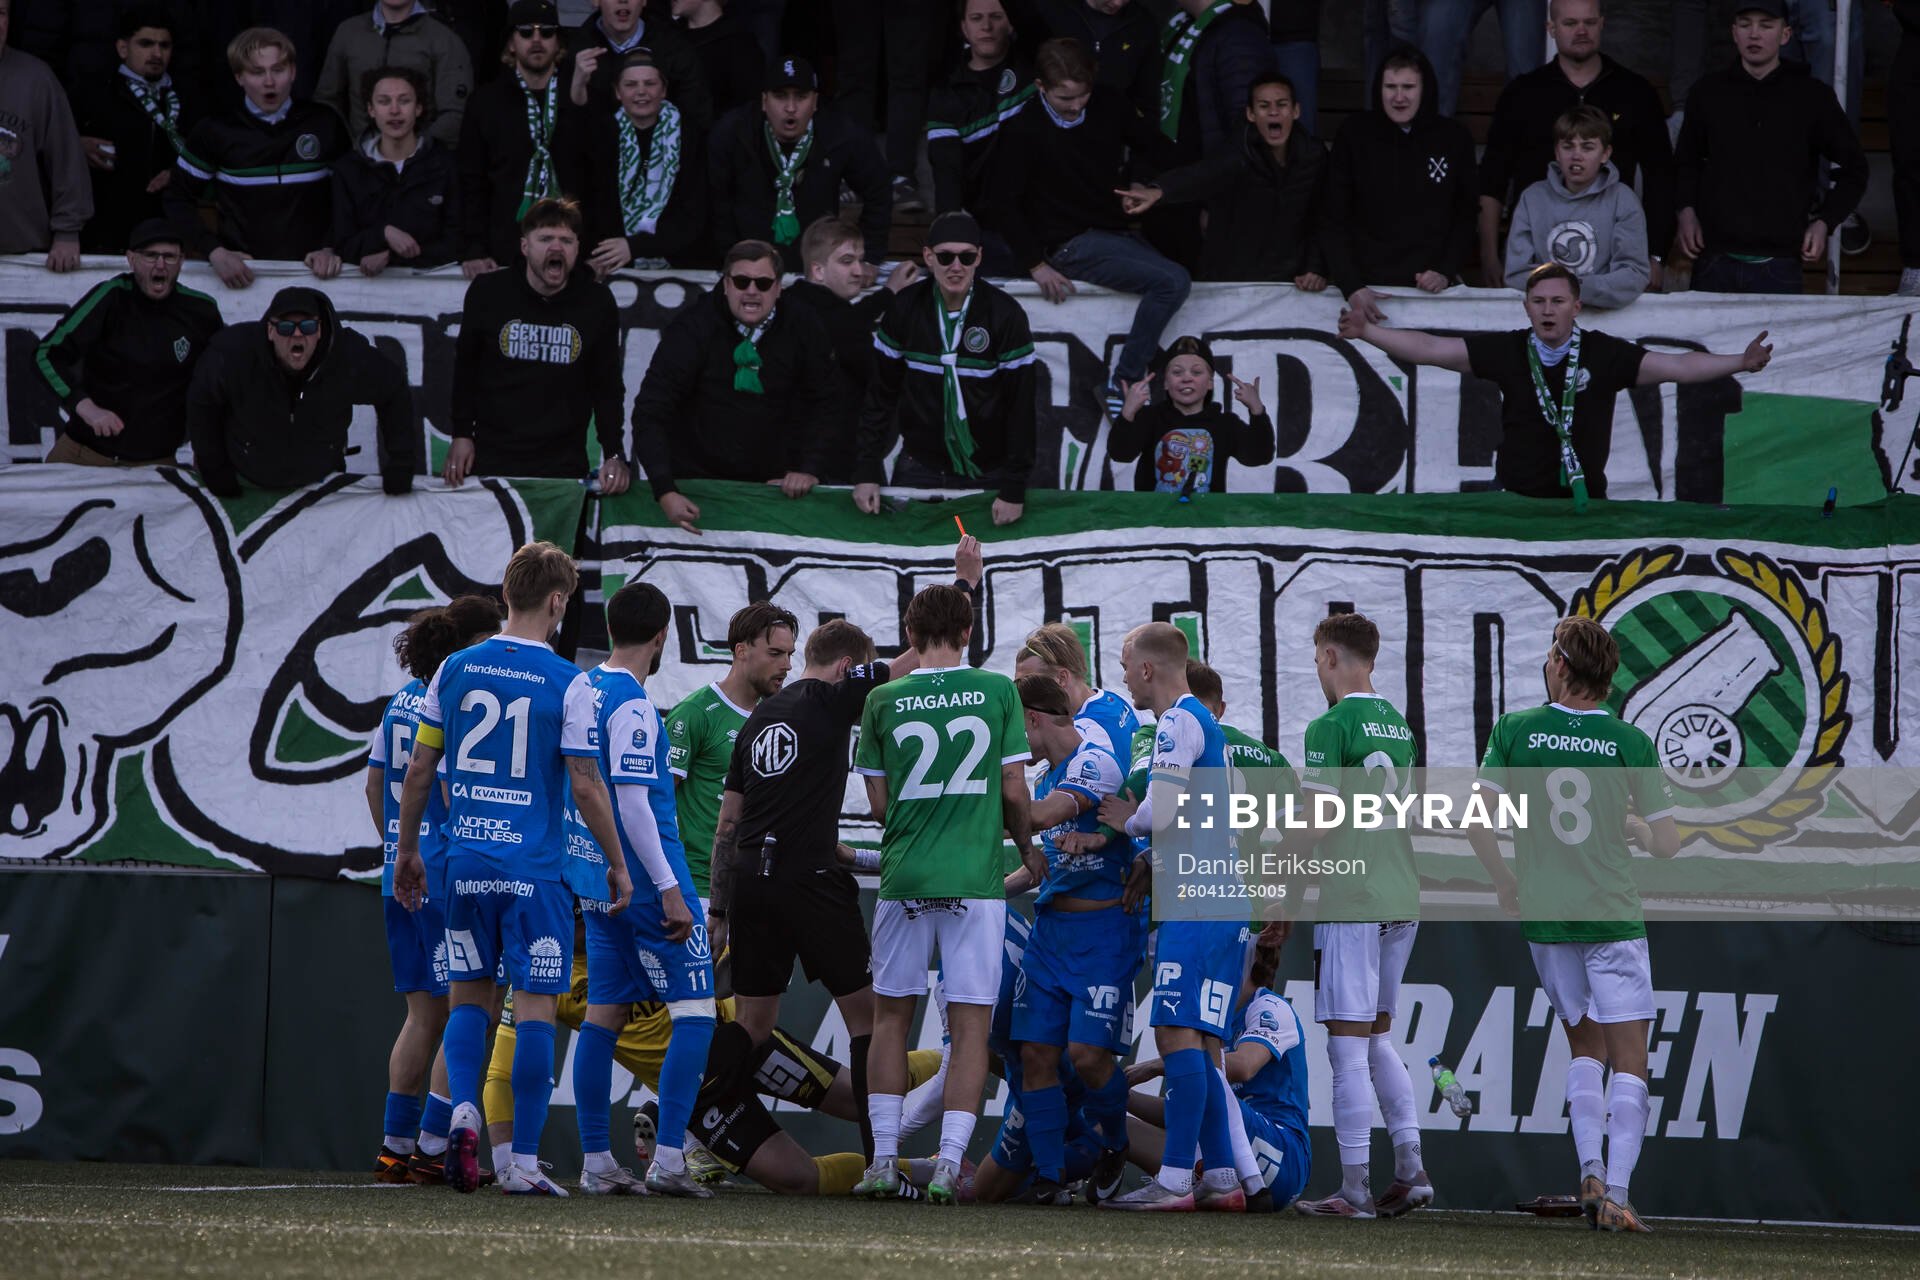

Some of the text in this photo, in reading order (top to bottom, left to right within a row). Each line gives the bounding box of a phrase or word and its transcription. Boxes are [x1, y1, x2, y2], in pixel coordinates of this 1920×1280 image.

[509, 322, 572, 345] SEKTION
[463, 663, 546, 685] Handelsbanken
[895, 691, 986, 713] STAGAARD
[455, 689, 532, 778] 21
[1528, 733, 1617, 757] SPORRONG
[623, 757, 652, 767] UNIBET
[754, 727, 794, 774] MG
[892, 715, 992, 801] 22
[474, 788, 529, 802] KVANTUM
[1545, 767, 1593, 846] 8
[459, 815, 511, 830] NORDIC
[455, 879, 535, 897] Autoexperten
[531, 956, 563, 968] OHUS
[687, 969, 708, 992] 11
[1087, 984, 1120, 1010] YP
